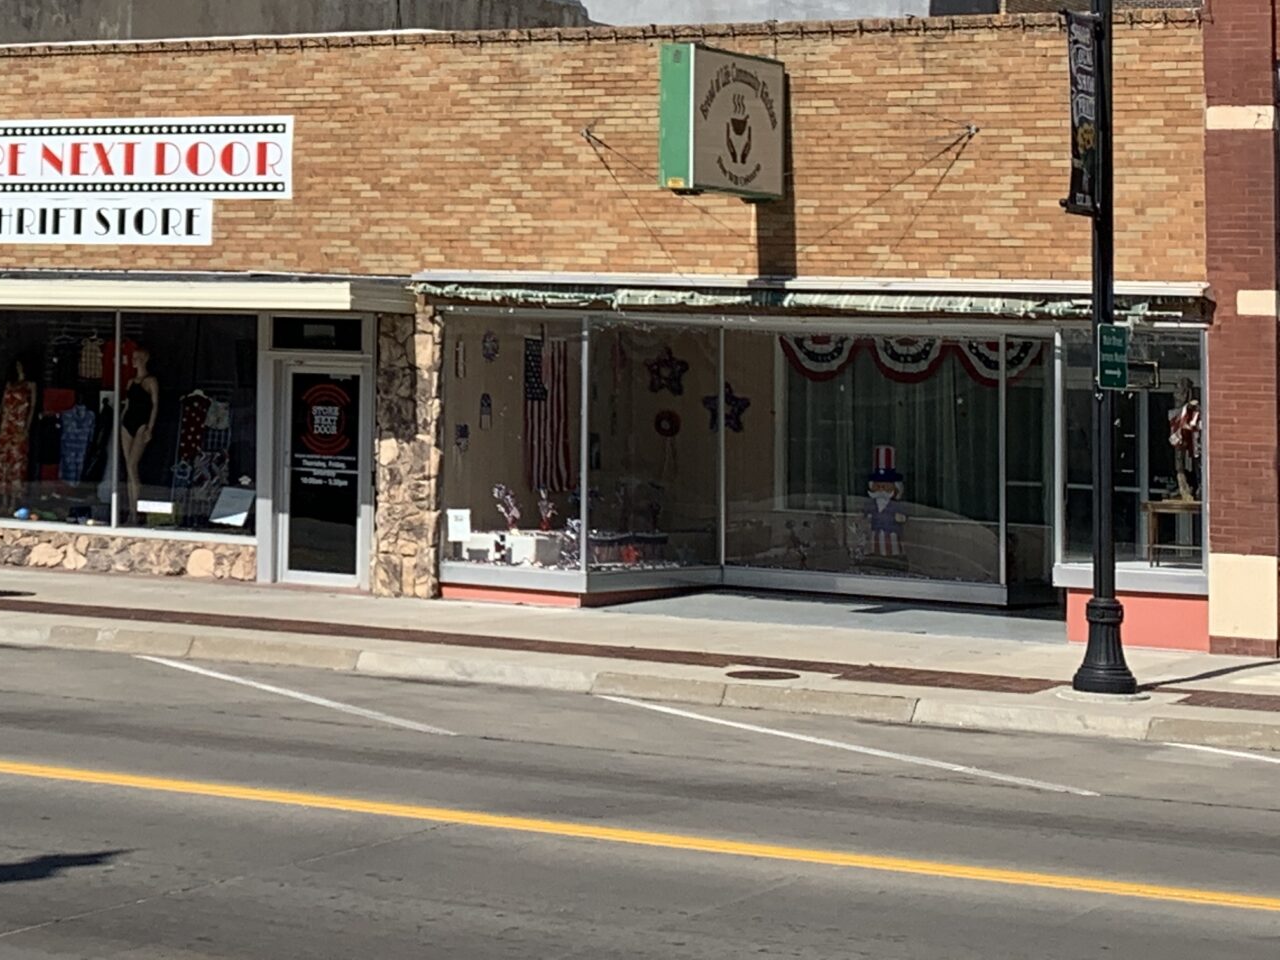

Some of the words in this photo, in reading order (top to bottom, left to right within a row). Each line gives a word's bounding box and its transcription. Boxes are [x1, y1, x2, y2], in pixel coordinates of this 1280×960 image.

[40, 142, 141, 177] NEXT
[155, 141, 283, 177] DOOR
[94, 207, 202, 236] STORE
[312, 406, 339, 416] STORE
[314, 415, 338, 425] NEXT
[313, 424, 337, 435] DOOR
